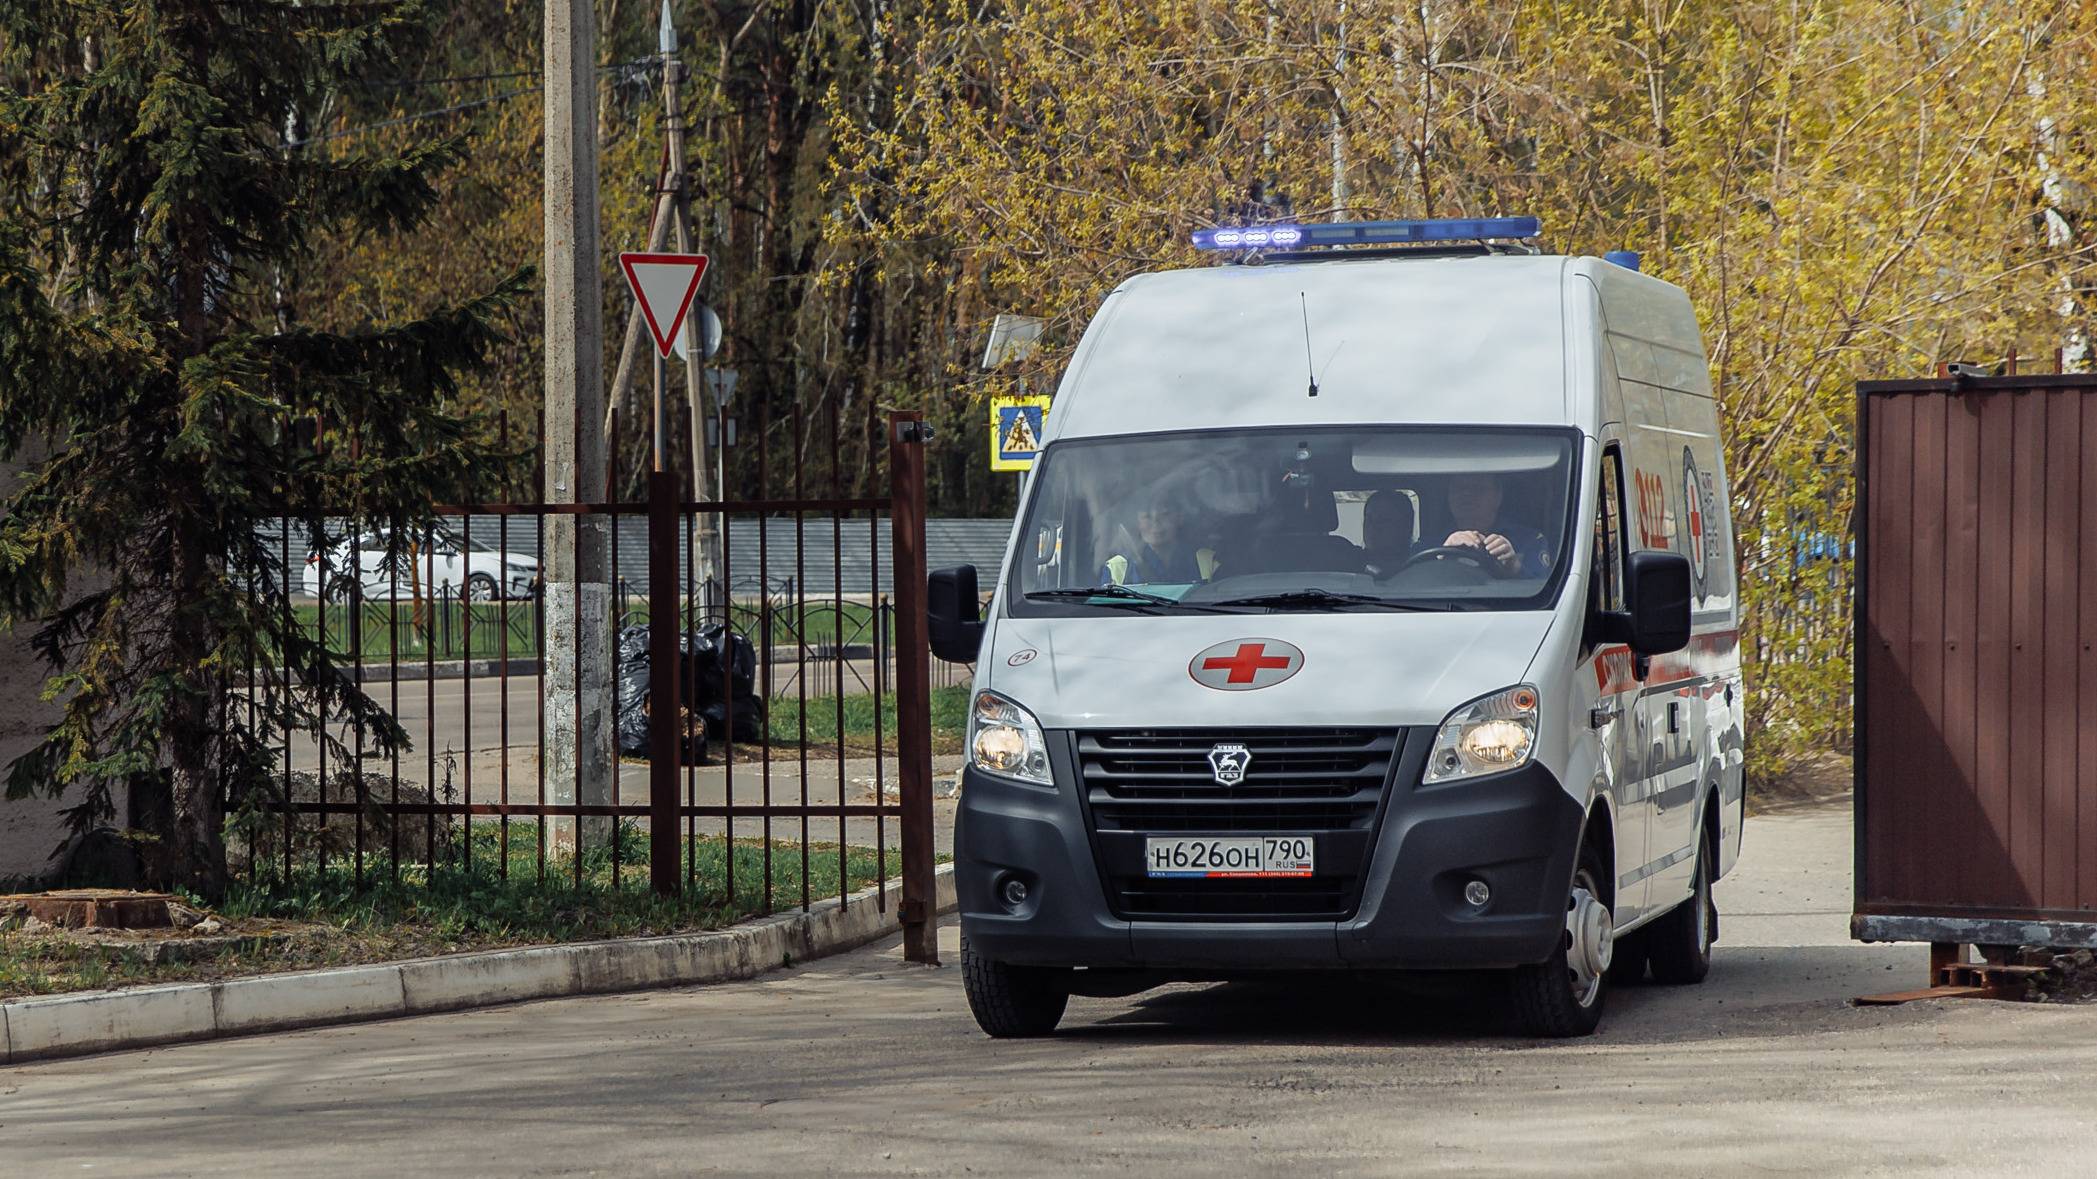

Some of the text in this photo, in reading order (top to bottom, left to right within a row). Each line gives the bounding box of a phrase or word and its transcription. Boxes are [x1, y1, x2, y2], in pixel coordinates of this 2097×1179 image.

[1014, 653, 1030, 663] 74
[1156, 840, 1306, 867] Н626ОН 790
[1275, 860, 1296, 869] RUS
